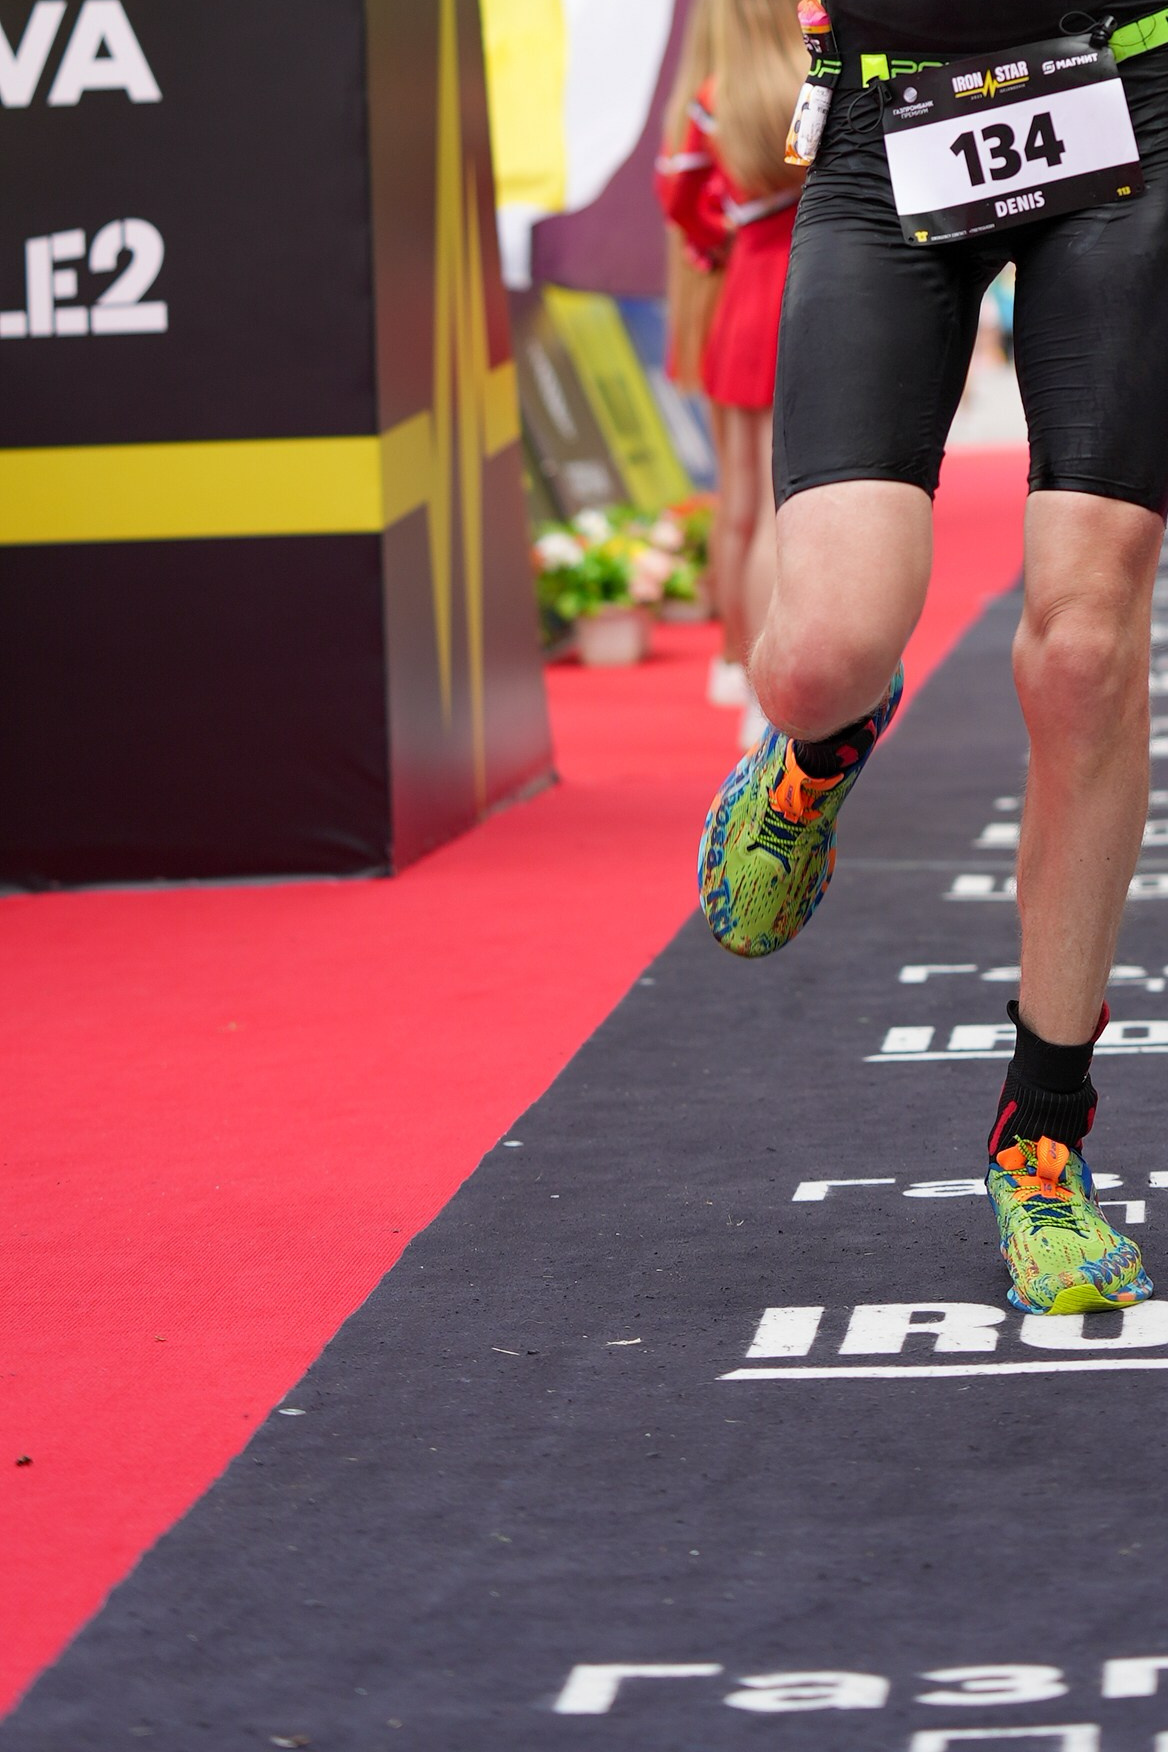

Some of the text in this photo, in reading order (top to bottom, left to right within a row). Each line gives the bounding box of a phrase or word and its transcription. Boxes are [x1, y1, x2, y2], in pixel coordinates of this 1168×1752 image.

[952, 71, 984, 93] IRON
[995, 60, 1029, 83] STAR
[1055, 52, 1098, 71] МАГНИТ
[949, 111, 1066, 187] 134
[995, 191, 1046, 218] DENIS
